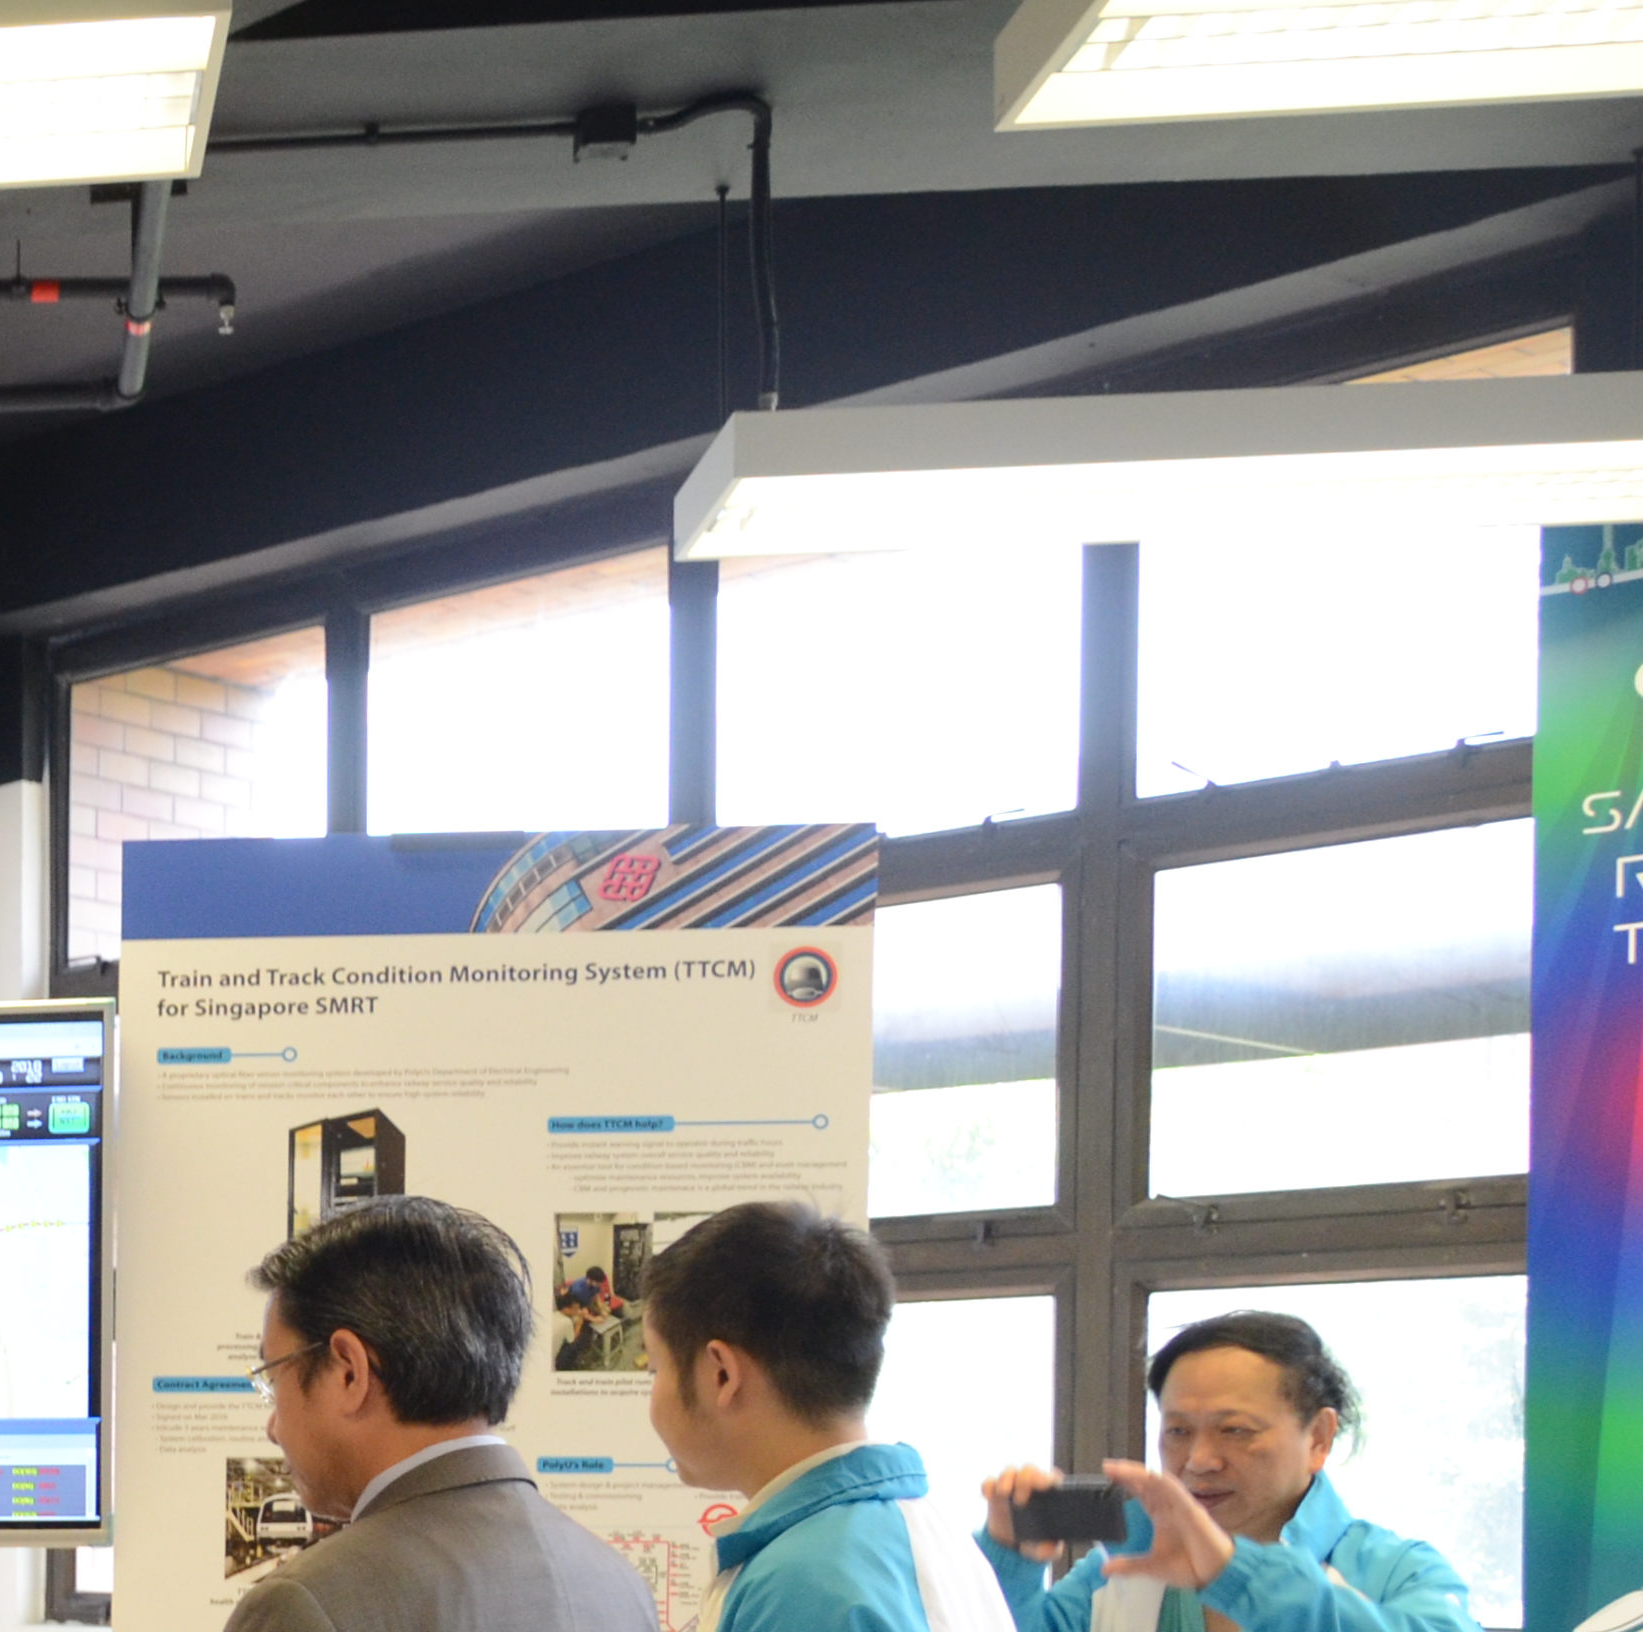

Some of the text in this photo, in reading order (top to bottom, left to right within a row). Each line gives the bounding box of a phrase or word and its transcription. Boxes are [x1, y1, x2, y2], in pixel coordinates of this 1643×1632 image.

[1582, 788, 1643, 834] S
[158, 959, 756, 988] Train and Track Condition Monitoring System (TTCM)
[157, 996, 379, 1021] for Singapore SMRT
[791, 1013, 819, 1023] TTCM
[162, 1050, 223, 1062] Background
[552, 1119, 663, 1130] How does TTCM help?
[157, 1380, 254, 1391] Contract Agreemen
[542, 1460, 604, 1471] PolyU's Role
